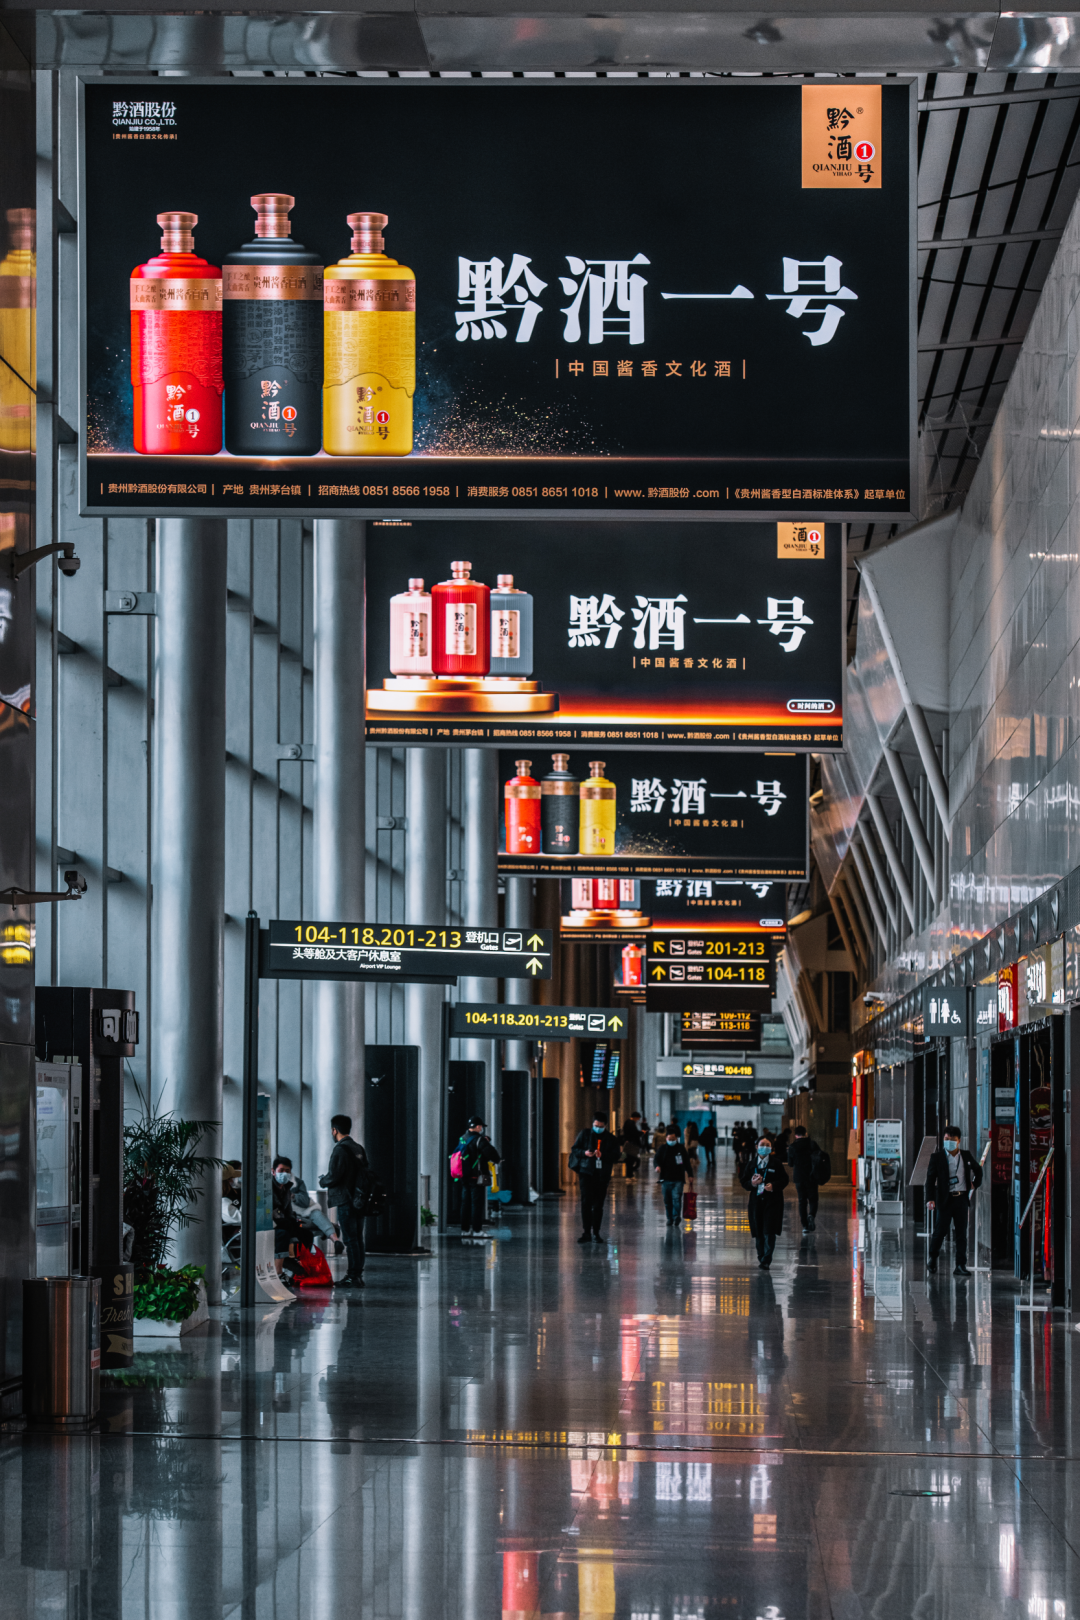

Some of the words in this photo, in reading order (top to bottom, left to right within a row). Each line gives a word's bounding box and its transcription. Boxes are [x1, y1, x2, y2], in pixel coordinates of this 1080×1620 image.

[112, 101, 177, 118] 黔酒股份
[112, 118, 143, 126] QIANJIU
[812, 163, 852, 172] QIANJIU
[454, 252, 859, 347] 黔酒一号
[567, 359, 732, 377] 中国酱香文化酒
[108, 483, 207, 494] 贵州黔酒股份有限公司
[222, 484, 244, 495] 产地
[249, 484, 302, 496] 贵州茅台镇
[318, 485, 360, 497] 招商热线
[362, 486, 389, 496] 0851
[392, 486, 420, 496] 8566
[424, 486, 450, 496] 1958
[467, 486, 509, 497] 消费服务
[511, 487, 538, 497] 0851
[541, 487, 568, 497] 8651
[571, 487, 599, 498] 1018
[864, 489, 906, 500] 起草单位
[567, 593, 814, 653] 黔酒一号
[640, 657, 737, 669] 中国酱香文化酒
[642, 731, 659, 739] 1018
[630, 777, 787, 816] 黔酒一号
[465, 931, 499, 943] 登机口
[705, 941, 765, 955] 201-213
[292, 948, 402, 963] 头等舱及大客户休息室
[706, 967, 765, 980] 104-118
[724, 1066, 752, 1075] 104-118
